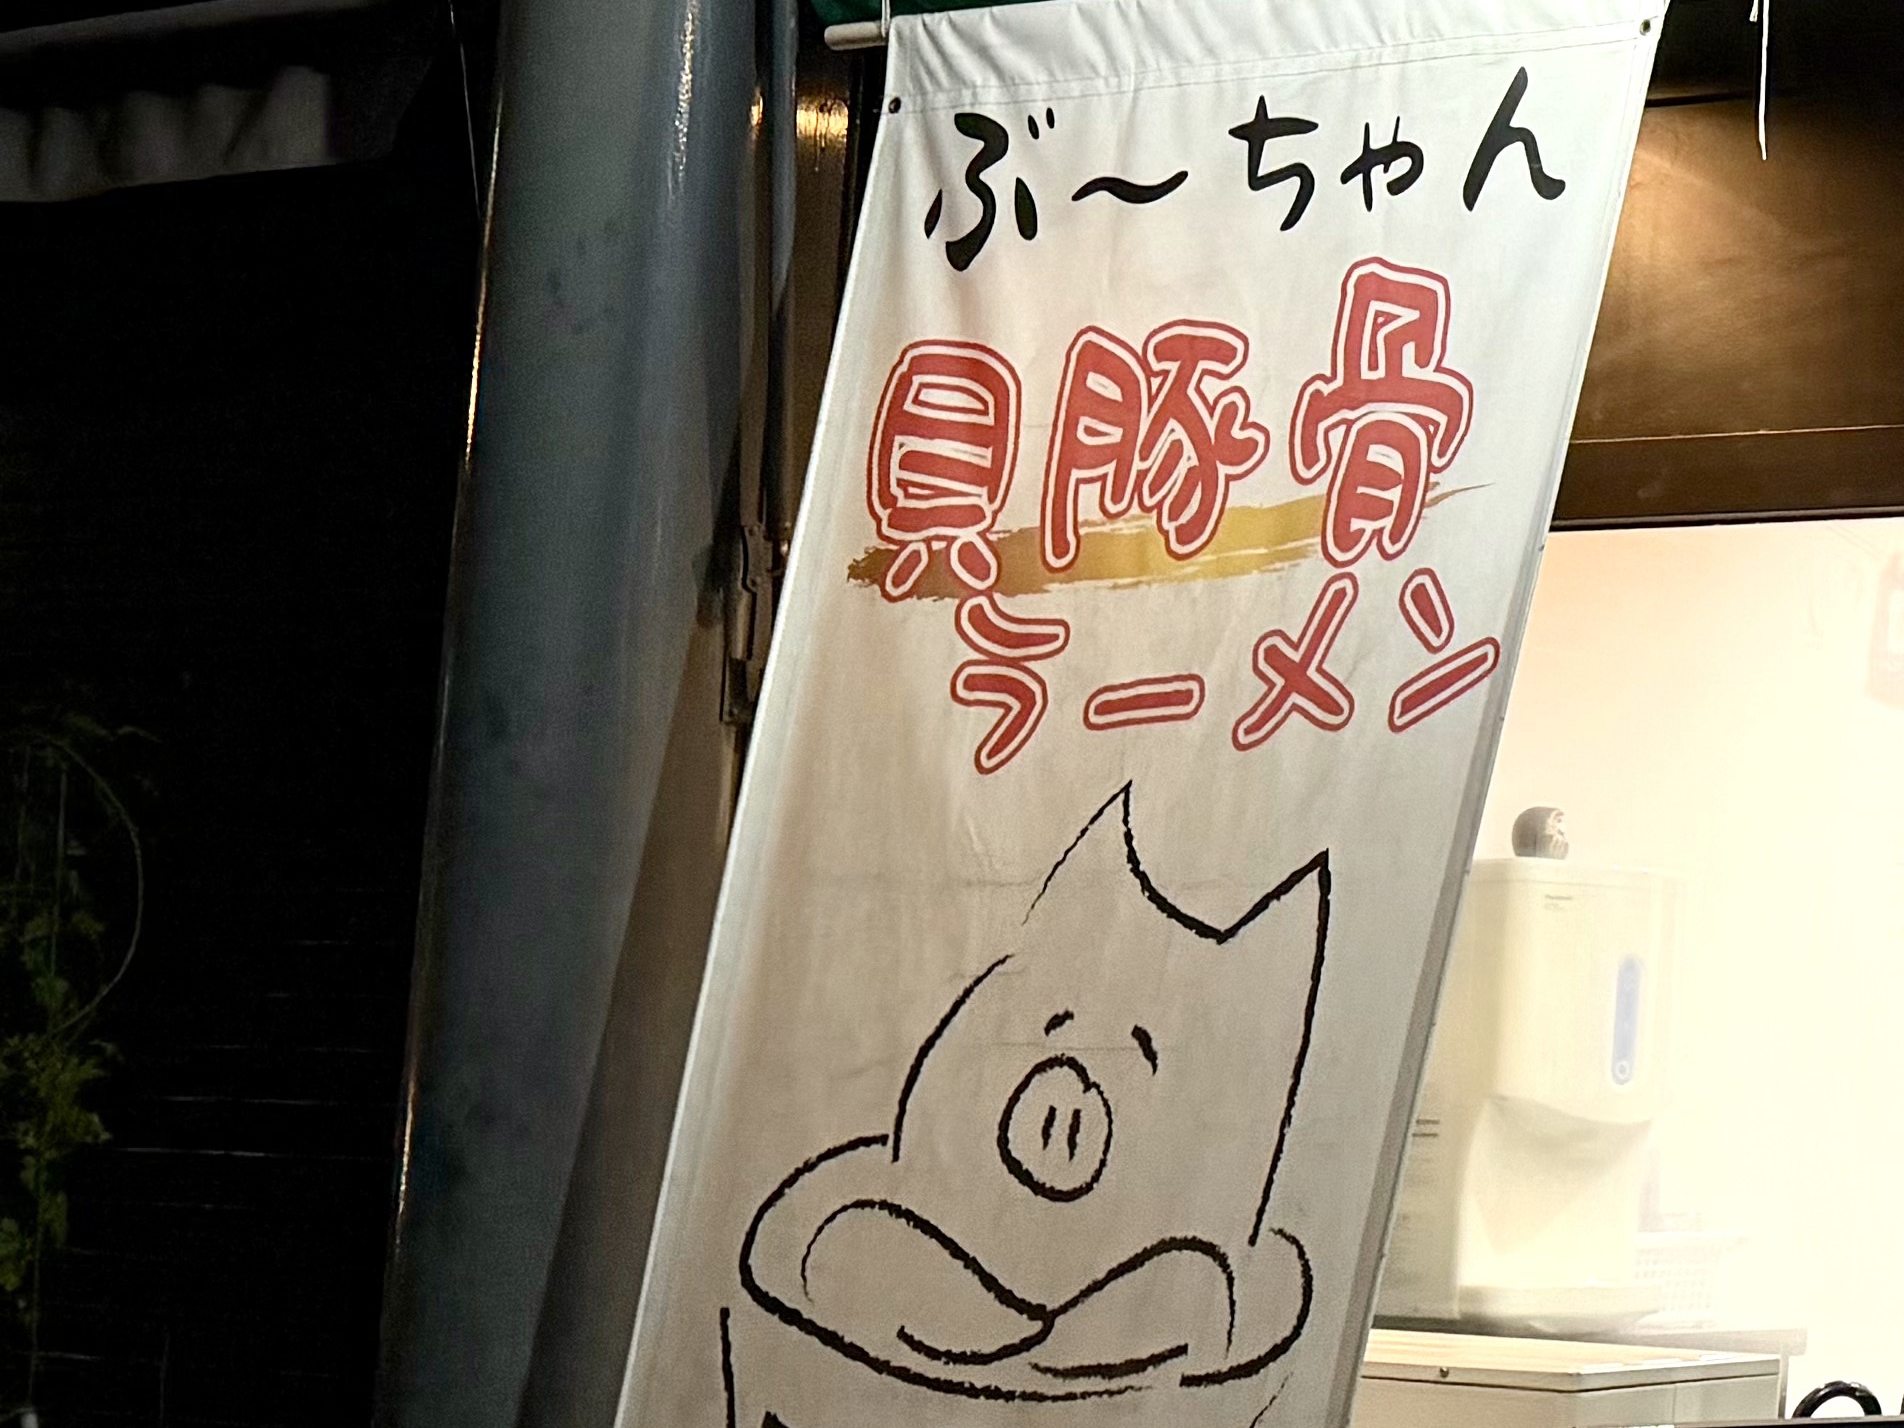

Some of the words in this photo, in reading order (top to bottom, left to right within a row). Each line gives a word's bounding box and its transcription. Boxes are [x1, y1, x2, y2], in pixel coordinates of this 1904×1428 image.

[867, 257, 1473, 602] 貝豚骨
[951, 567, 1500, 775] ラーメン
